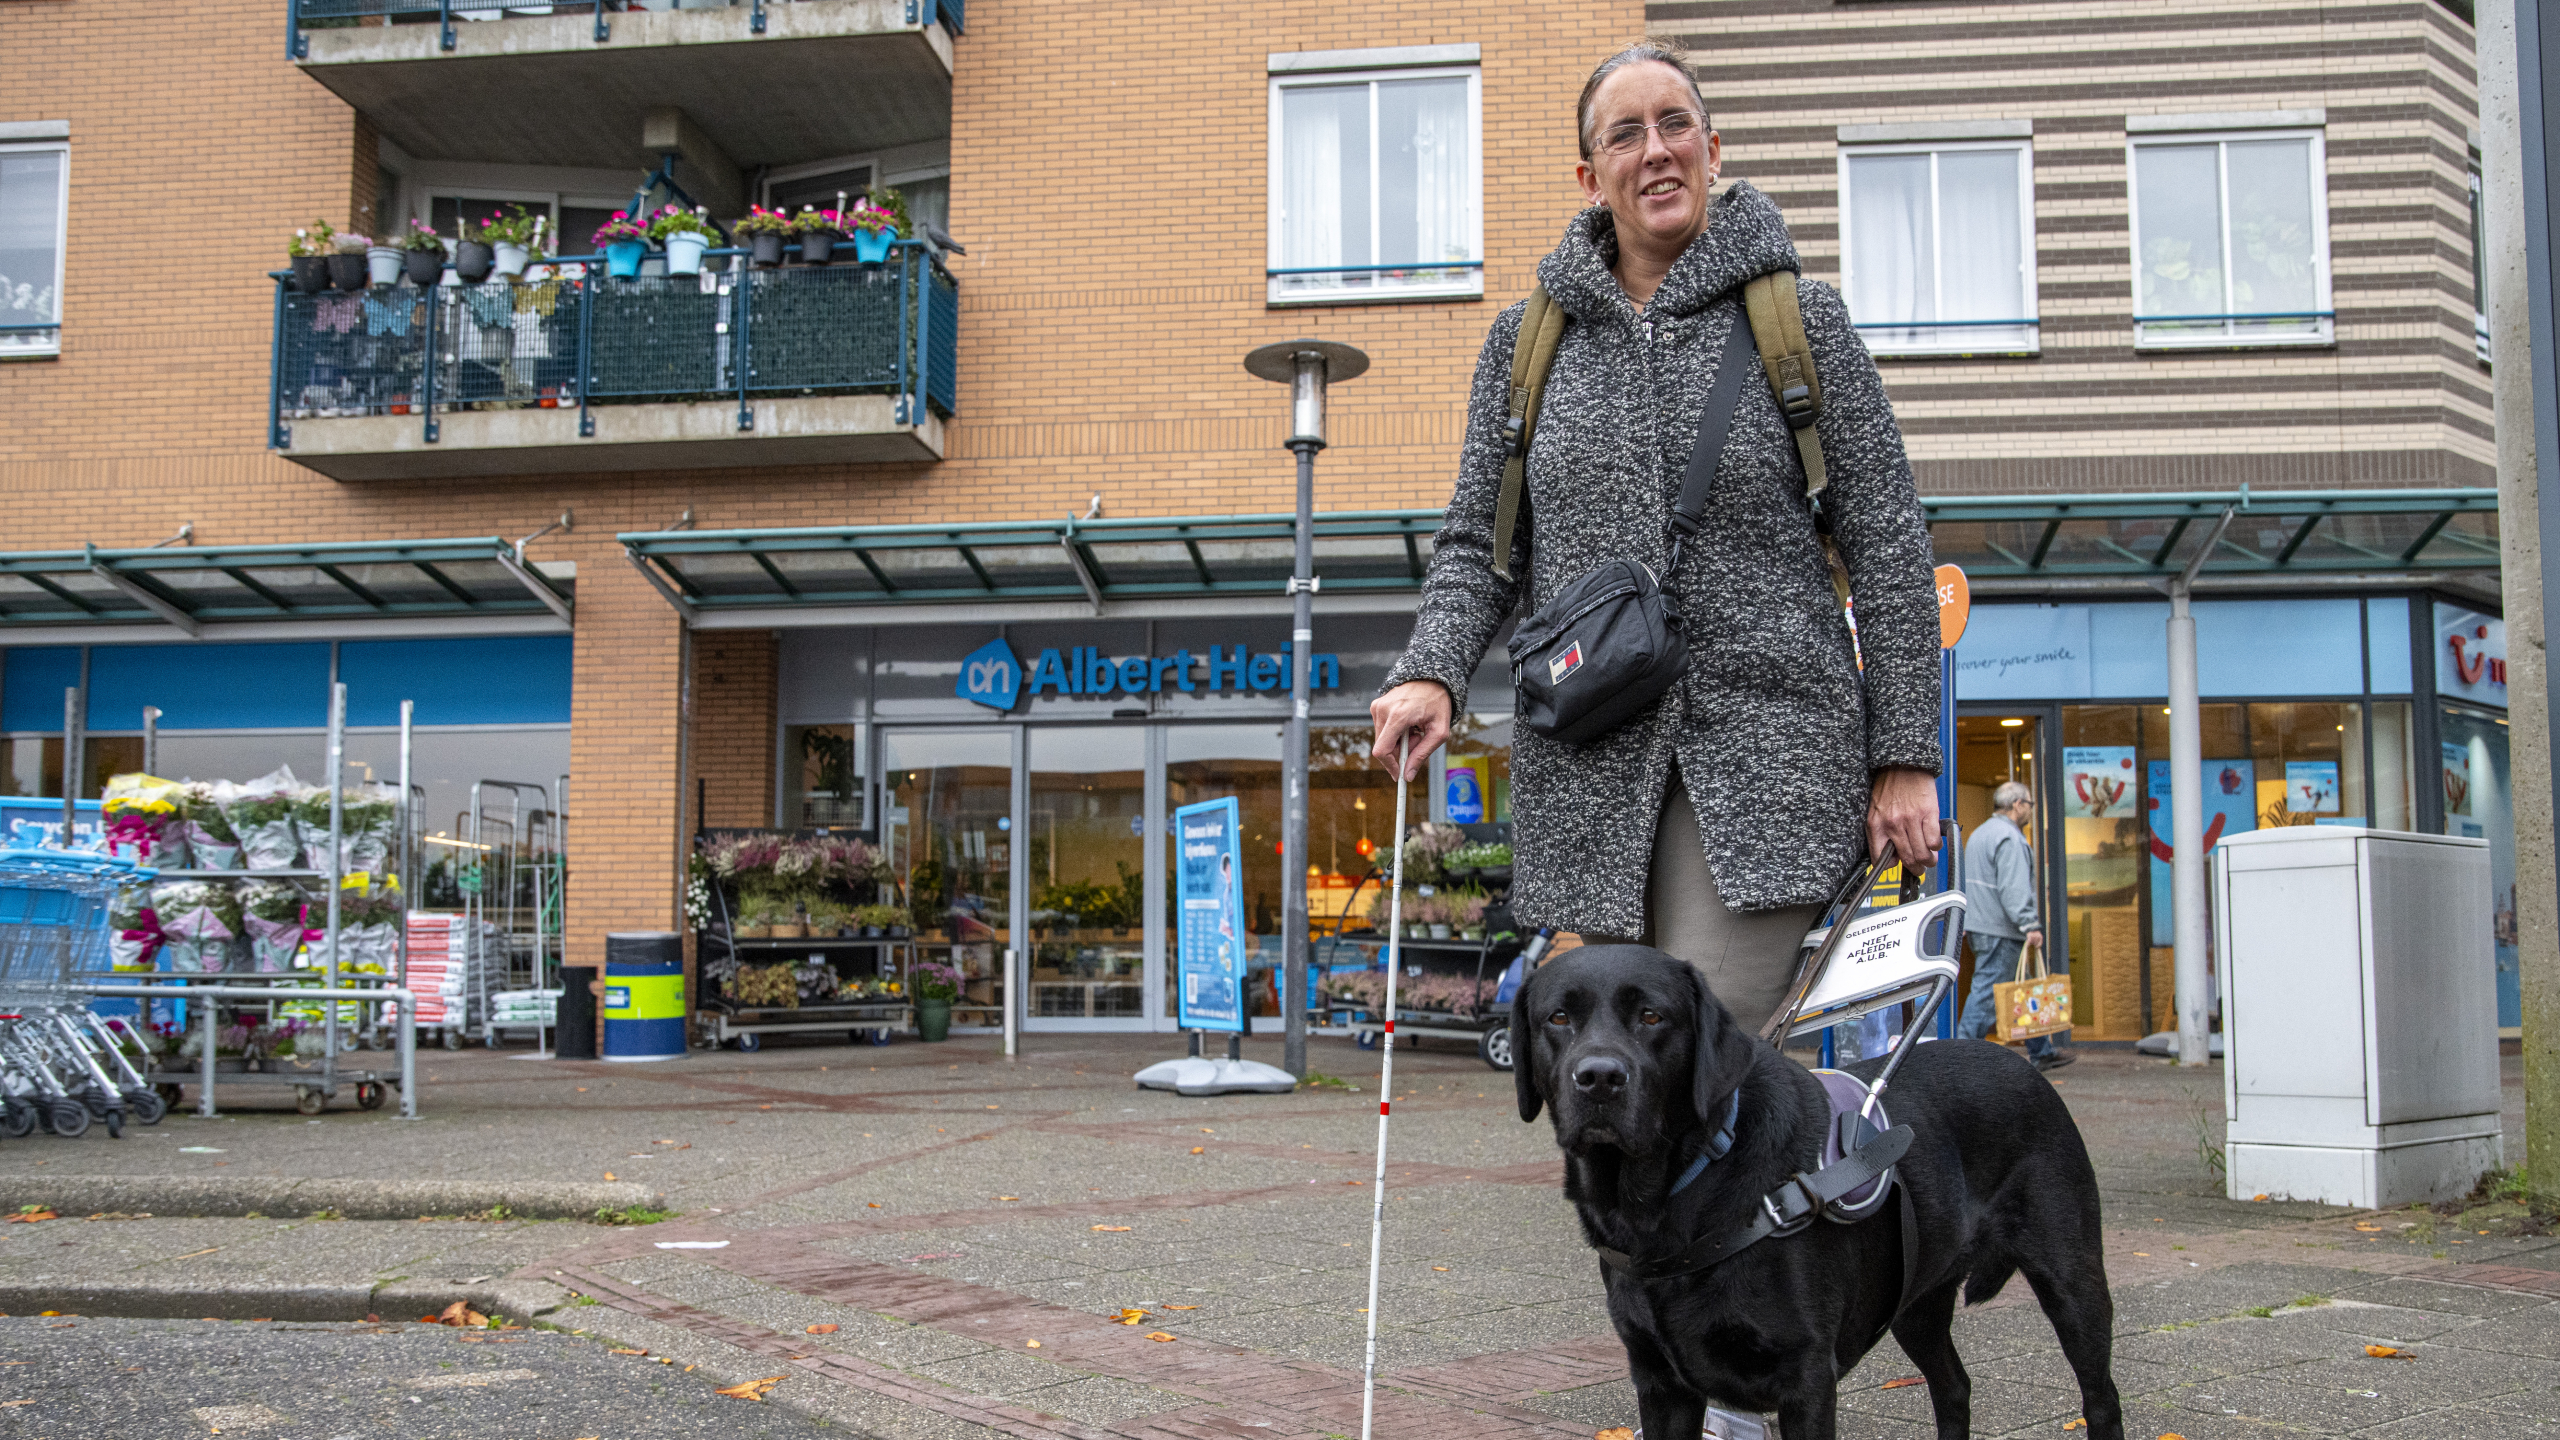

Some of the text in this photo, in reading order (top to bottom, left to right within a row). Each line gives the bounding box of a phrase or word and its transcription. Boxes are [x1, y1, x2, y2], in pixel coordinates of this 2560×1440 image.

[1936, 583, 1954, 606] SE
[1028, 645, 1196, 695] Albert
[1209, 641, 1340, 699] Hein
[1956, 646, 2076, 678] scover your smile
[1845, 916, 1908, 939] GELEIDEHOND
[1847, 939, 1901, 960] AFLEIDEN
[1862, 933, 1889, 948] NIET
[1856, 951, 1888, 964] A.U.B.
